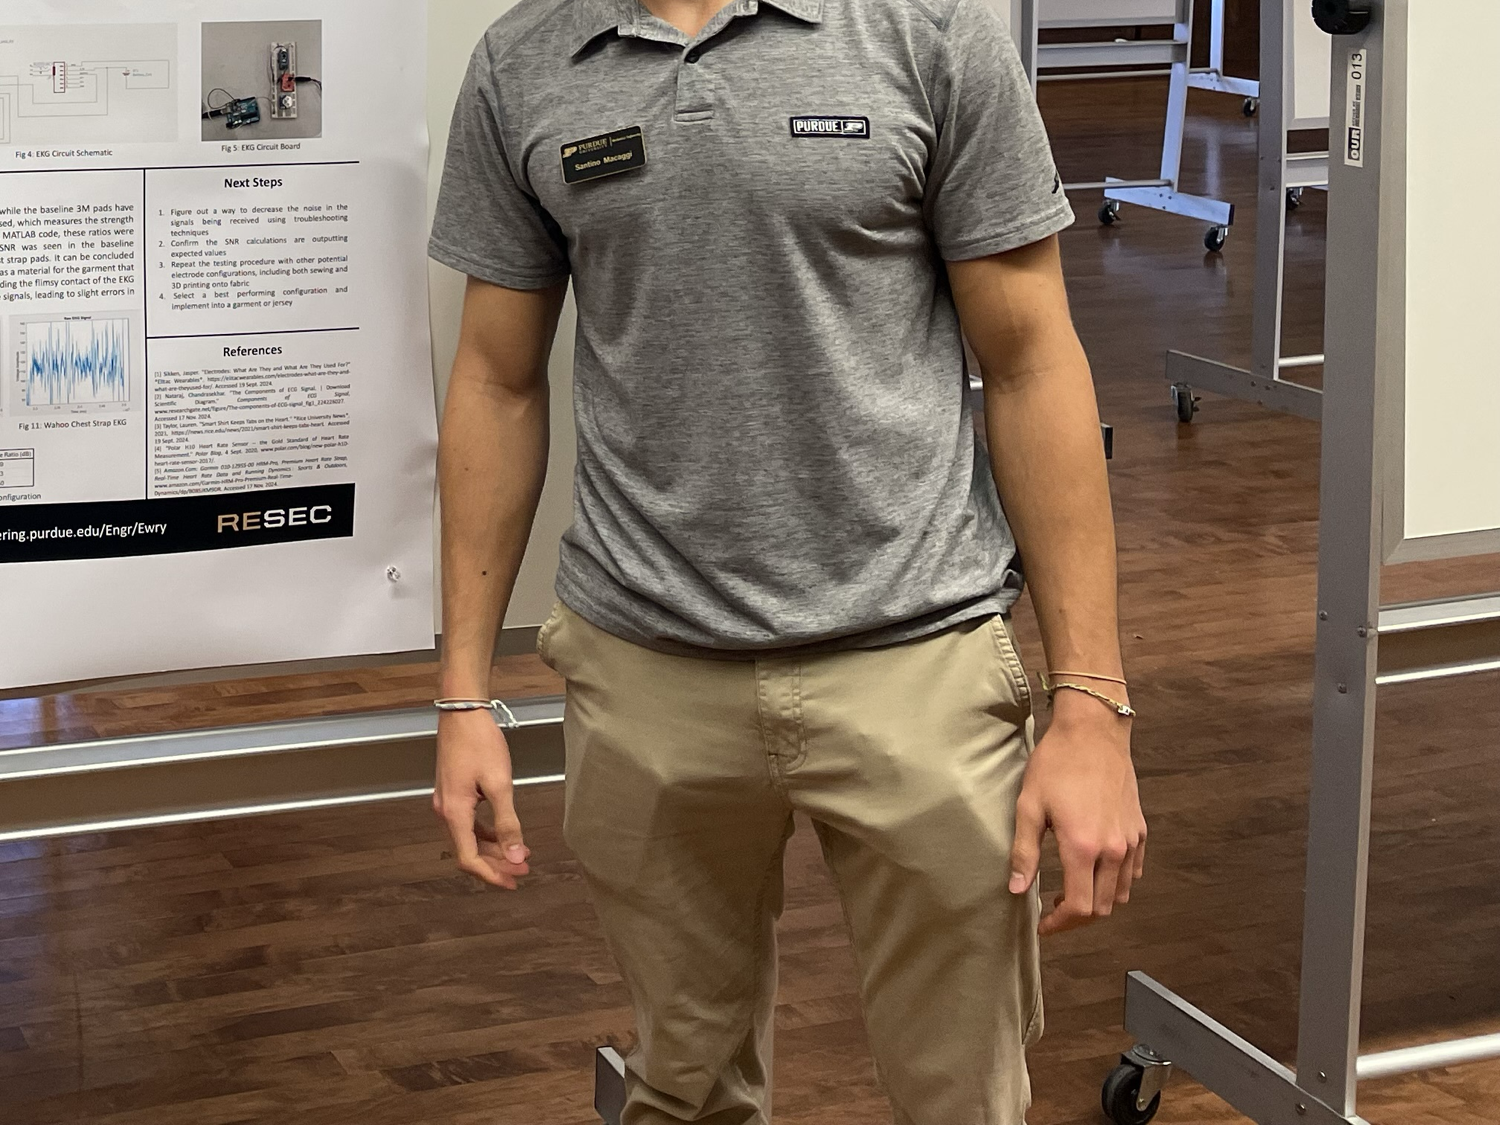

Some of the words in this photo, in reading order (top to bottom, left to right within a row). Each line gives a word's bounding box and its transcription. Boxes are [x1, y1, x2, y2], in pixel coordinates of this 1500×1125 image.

[1351, 53, 1363, 80] 013
[796, 120, 840, 132] PURDUE
[221, 144, 231, 153] Fig
[241, 143, 255, 151] EKG
[256, 143, 278, 151] Circuit
[280, 142, 300, 150] Board
[577, 138, 608, 151] PURDUE
[1350, 129, 1360, 160] OUR
[15, 151, 26, 159] Fig
[35, 150, 50, 158] EKG
[51, 149, 75, 157] Circuit
[76, 149, 113, 157] Schematic
[574, 158, 601, 171] Santino
[602, 150, 633, 164] Macaggi
[224, 178, 250, 188] Next
[252, 177, 282, 189] Steps
[223, 345, 282, 357] References
[18, 422, 29, 431] Fig
[43, 421, 69, 429] Wahoo
[70, 420, 91, 428] Chest
[92, 419, 111, 428] Strap
[112, 418, 127, 426] EKG
[216, 504, 332, 533] RESEC
